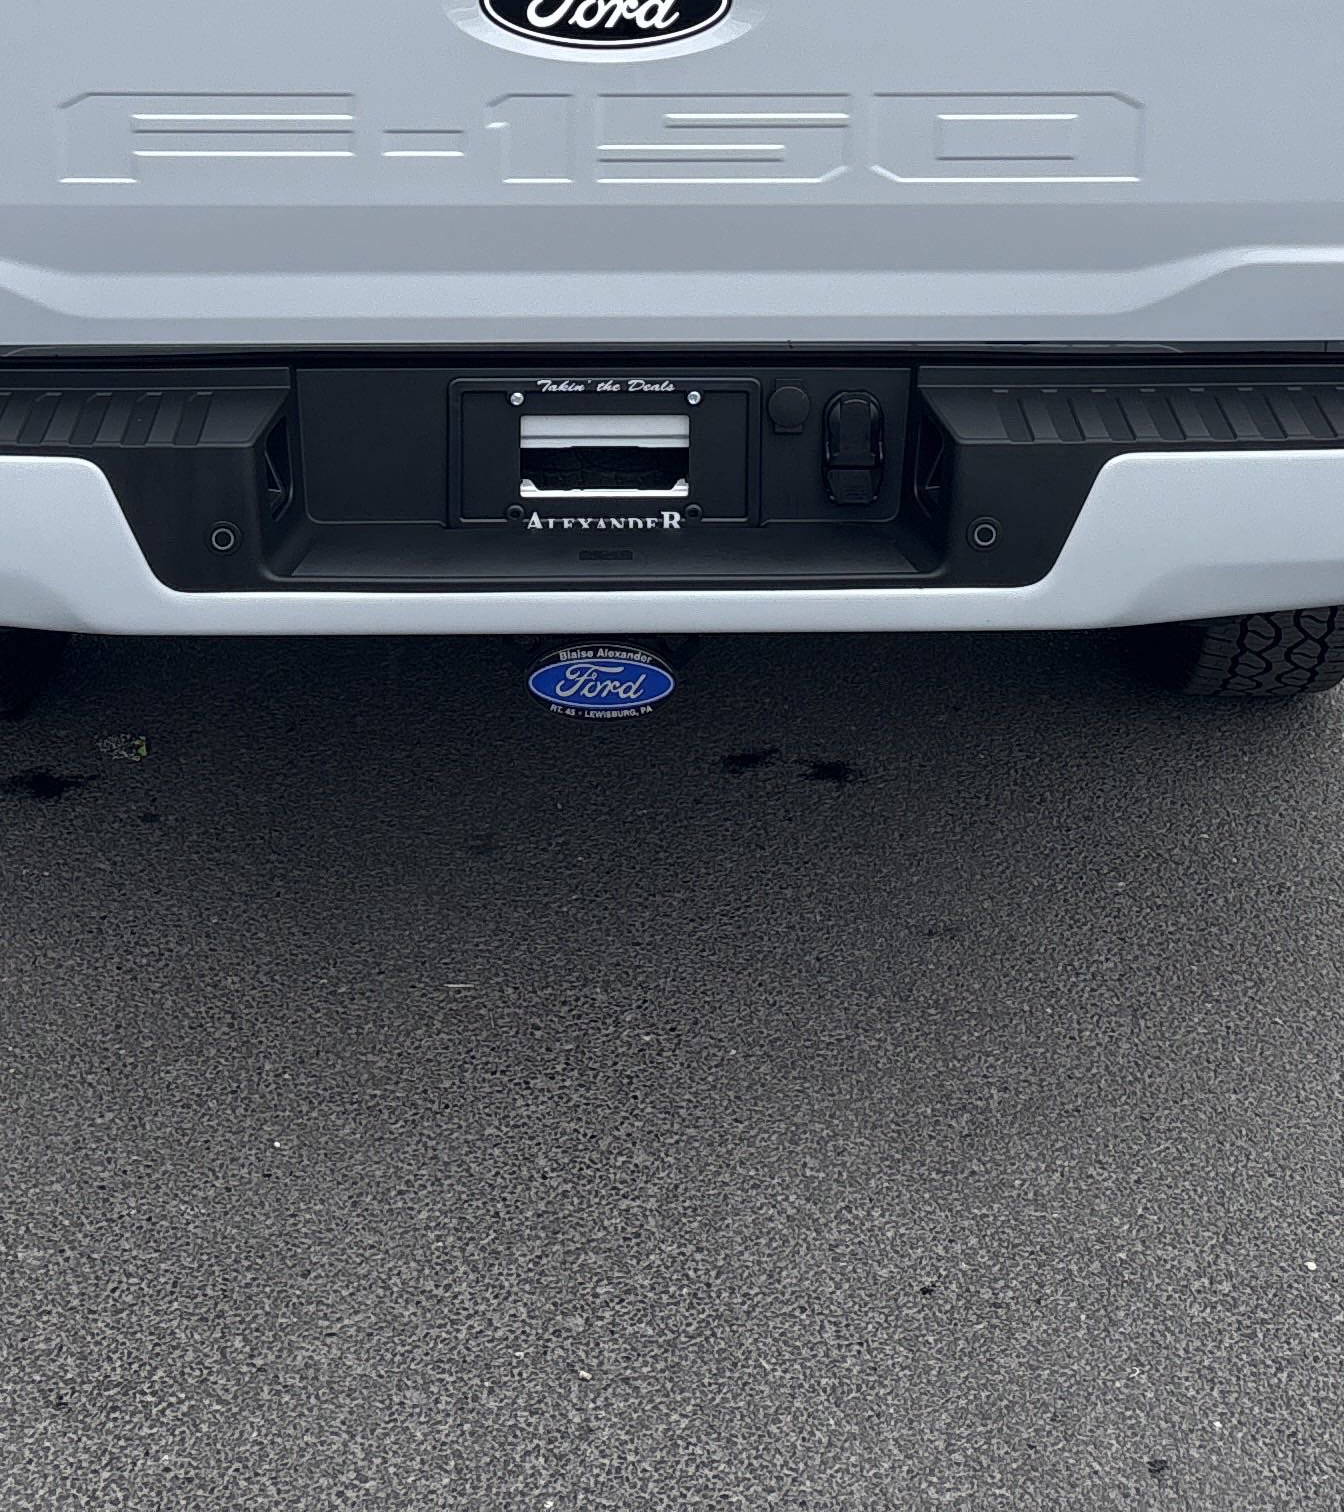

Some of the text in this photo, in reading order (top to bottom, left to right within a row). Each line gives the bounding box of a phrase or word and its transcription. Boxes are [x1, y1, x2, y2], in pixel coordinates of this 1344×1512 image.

[58, 92, 1144, 183] F-150
[536, 379, 676, 392] Takin' the Deals
[559, 648, 653, 663] Blaise Alexander
[555, 663, 646, 699] Ford
[565, 707, 576, 716] 45
[584, 708, 639, 719] LEWISBURG,
[640, 705, 653, 714] PA
